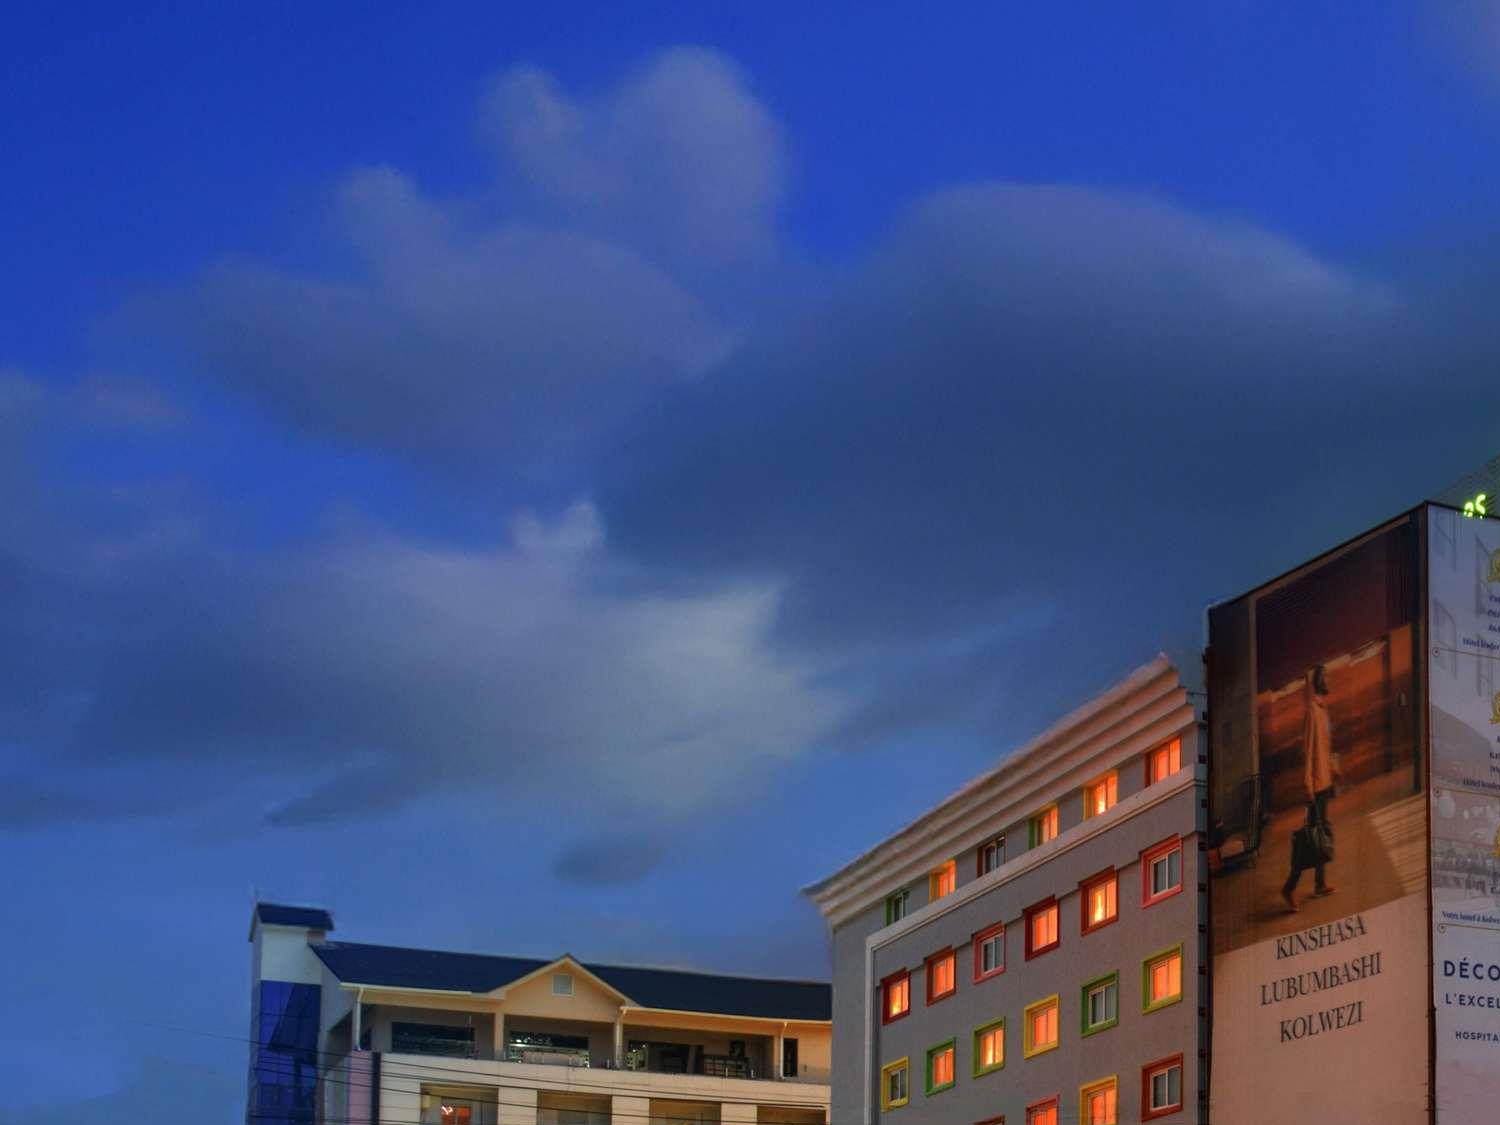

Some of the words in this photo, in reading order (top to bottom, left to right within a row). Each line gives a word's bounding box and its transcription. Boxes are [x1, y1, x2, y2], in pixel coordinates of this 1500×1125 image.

[1276, 914, 1367, 959] KINSHASA
[1261, 952, 1382, 1005] LUBUMBASHI
[1280, 1001, 1363, 1043] KOLWEZI
